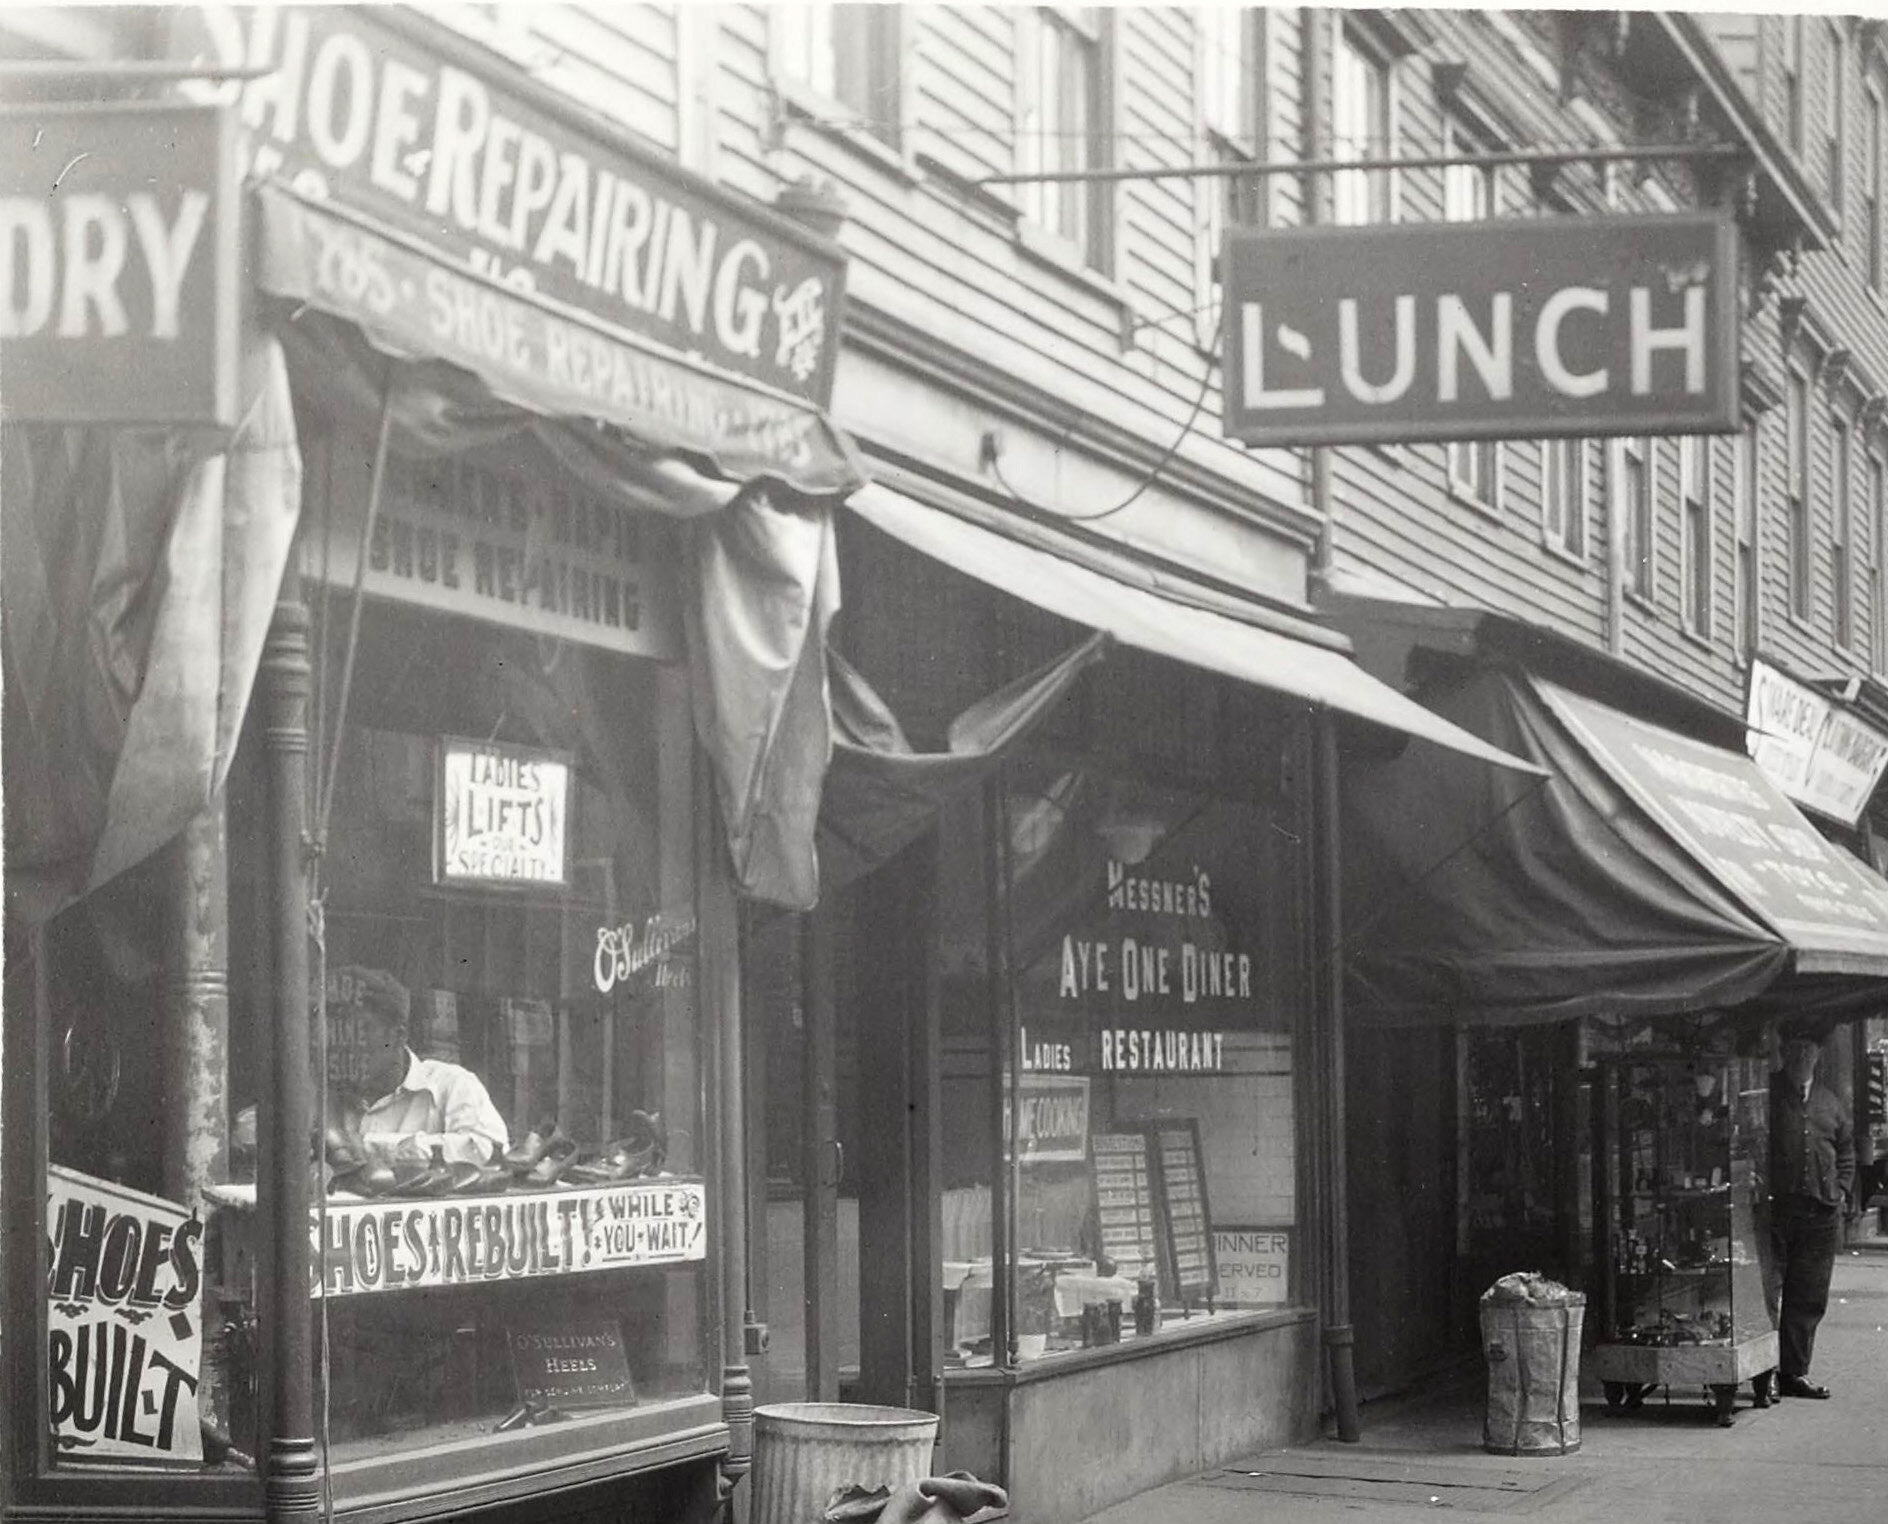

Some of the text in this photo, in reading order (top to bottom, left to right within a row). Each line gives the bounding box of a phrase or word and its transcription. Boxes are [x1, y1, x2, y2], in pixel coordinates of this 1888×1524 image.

[425, 66, 772, 356] REPAIRING
[0, 193, 208, 338] DRY
[426, 268, 530, 372] SHOE
[1242, 287, 1704, 408] LUNCH
[469, 752, 541, 792] LADIES
[468, 789, 544, 846] LIFTS
[1060, 934, 1251, 1002] AYE ONE DINER
[1021, 1026, 1071, 1070] LADIES
[1102, 1029, 1223, 1070] RESTAURANT
[608, 1193, 674, 1219] WHILE
[50, 1197, 203, 1305] HOES
[1217, 1234, 1286, 1254] INNER
[1220, 1263, 1281, 1278] ERVED
[545, 1358, 597, 1373] HEELS
